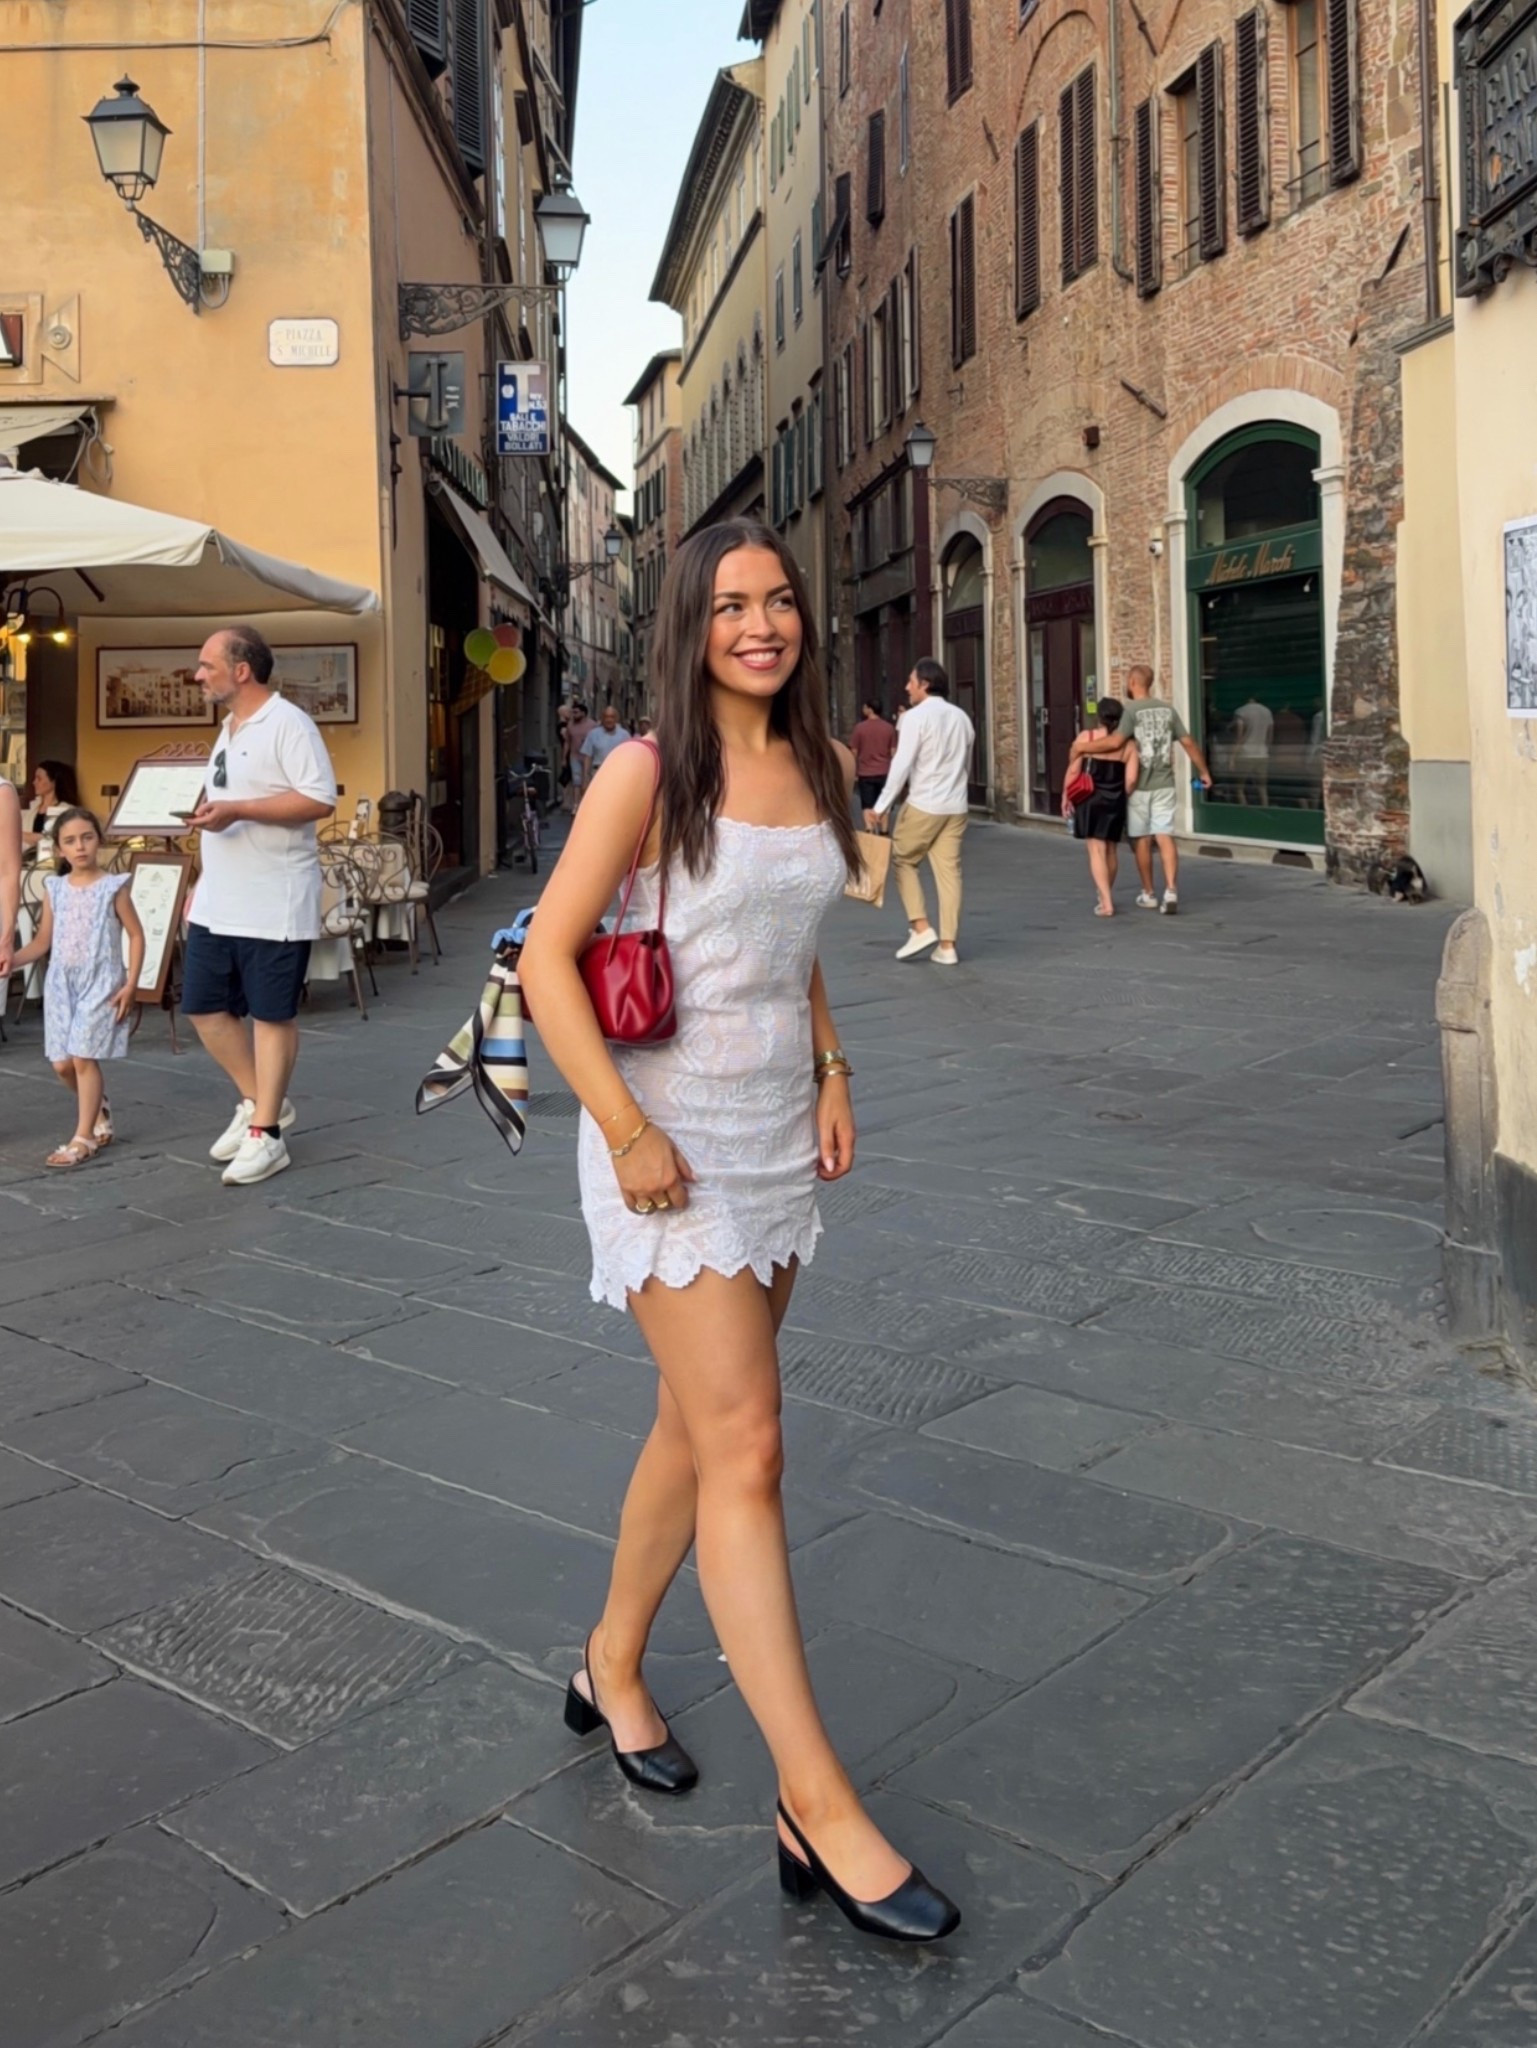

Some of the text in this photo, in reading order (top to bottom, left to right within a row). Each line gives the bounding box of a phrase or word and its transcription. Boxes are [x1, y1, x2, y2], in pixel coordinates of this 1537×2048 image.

[285, 328, 322, 341] PIAZZA
[291, 345, 331, 357] MICHELE
[504, 364, 540, 412] T
[500, 420, 546, 432] TABACCHI
[507, 432, 540, 442] VALORI
[504, 441, 542, 451] BOLLATI
